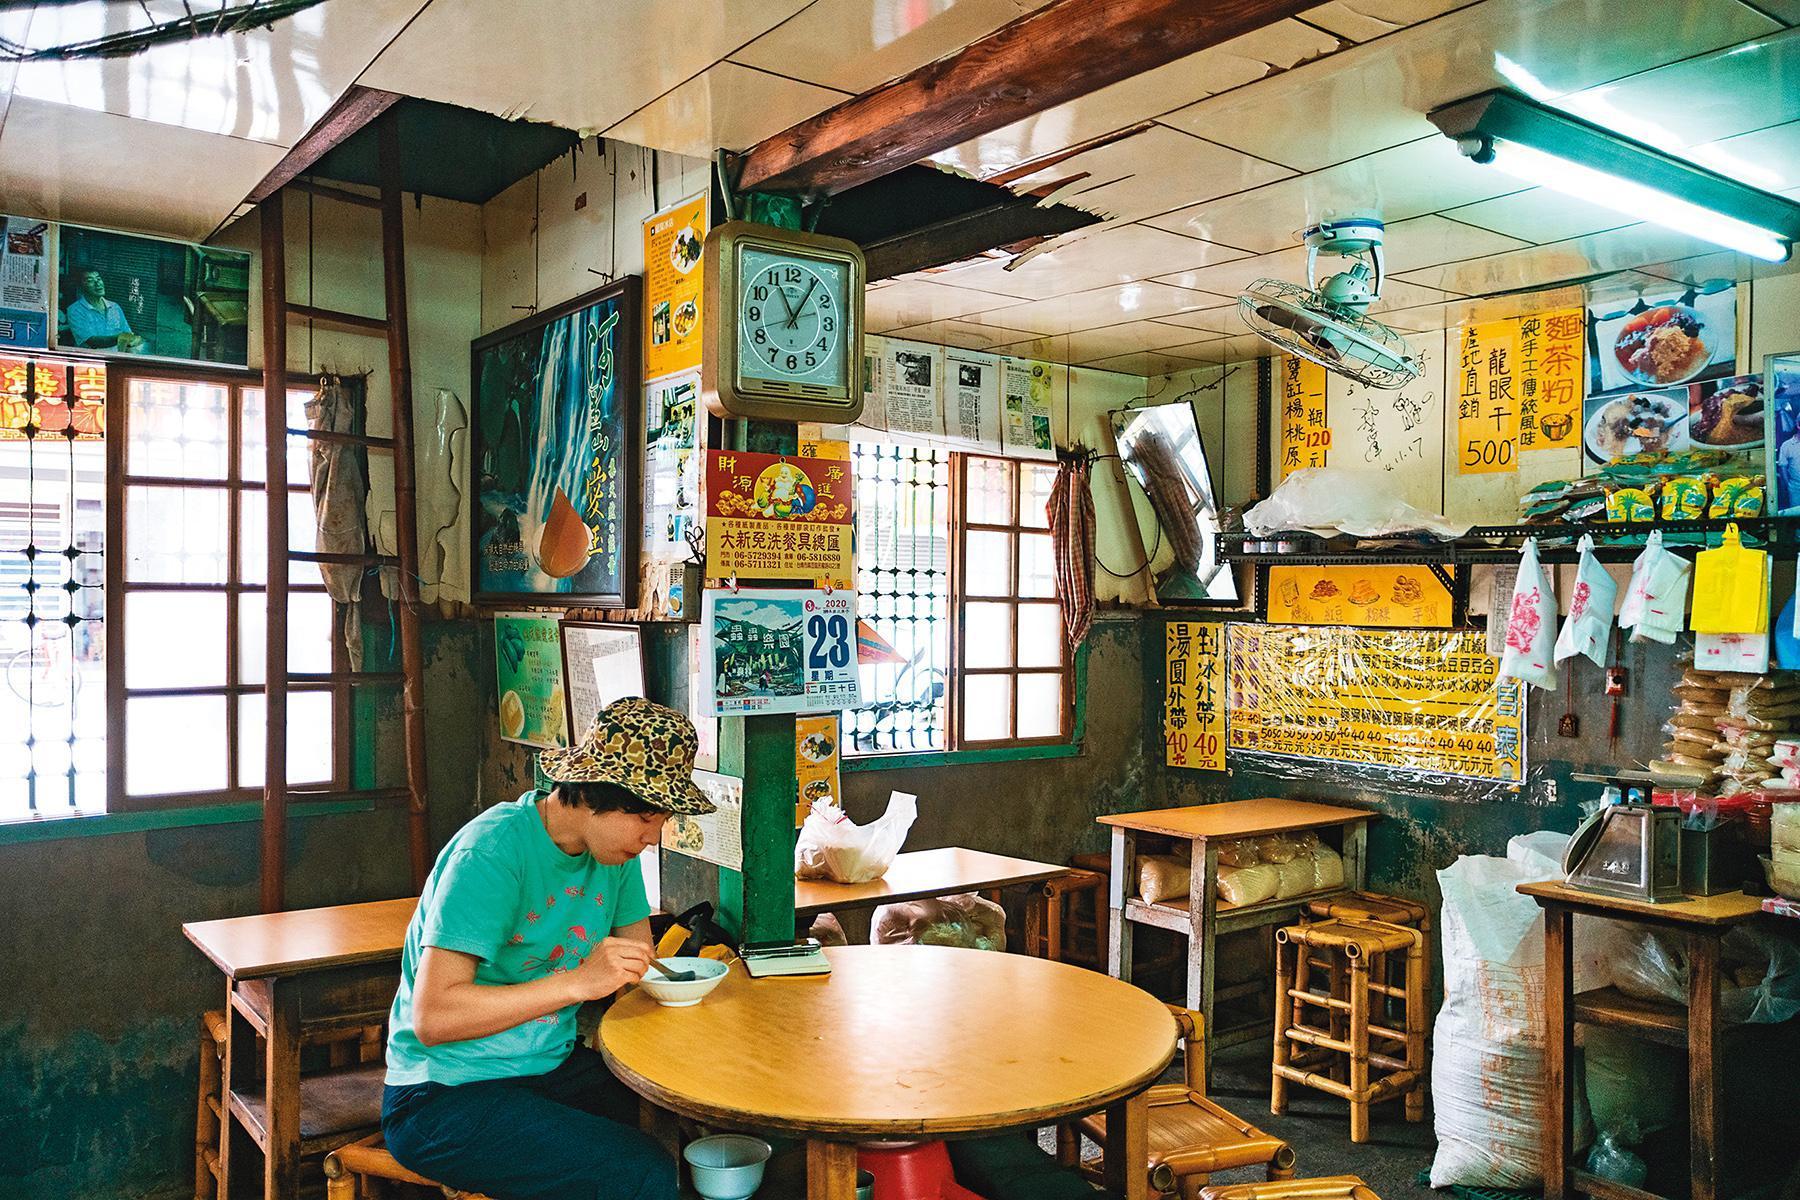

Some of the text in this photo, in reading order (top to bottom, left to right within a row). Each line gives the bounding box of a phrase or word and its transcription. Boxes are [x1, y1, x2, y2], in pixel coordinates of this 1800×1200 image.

[768, 271, 780, 286] 11
[785, 268, 801, 283] 12
[754, 285, 768, 301] 10
[820, 294, 830, 309] 2
[749, 307, 761, 321] 9
[823, 317, 834, 332] 3
[755, 329, 766, 344] 8
[816, 337, 827, 351] 4
[768, 348, 779, 362] 7
[786, 355, 797, 370] 6
[805, 352, 816, 366] 5
[1540, 314, 1581, 405] 麵茶粉
[1489, 348, 1515, 432] 龍眼干
[720, 530, 841, 552] 大新免洗餐具總匯
[734, 551, 781, 561] 06-5729394
[796, 553, 841, 562] 06-5816880
[734, 560, 781, 569] 06-5711321
[825, 600, 847, 608] 2020
[808, 615, 850, 669] 23
